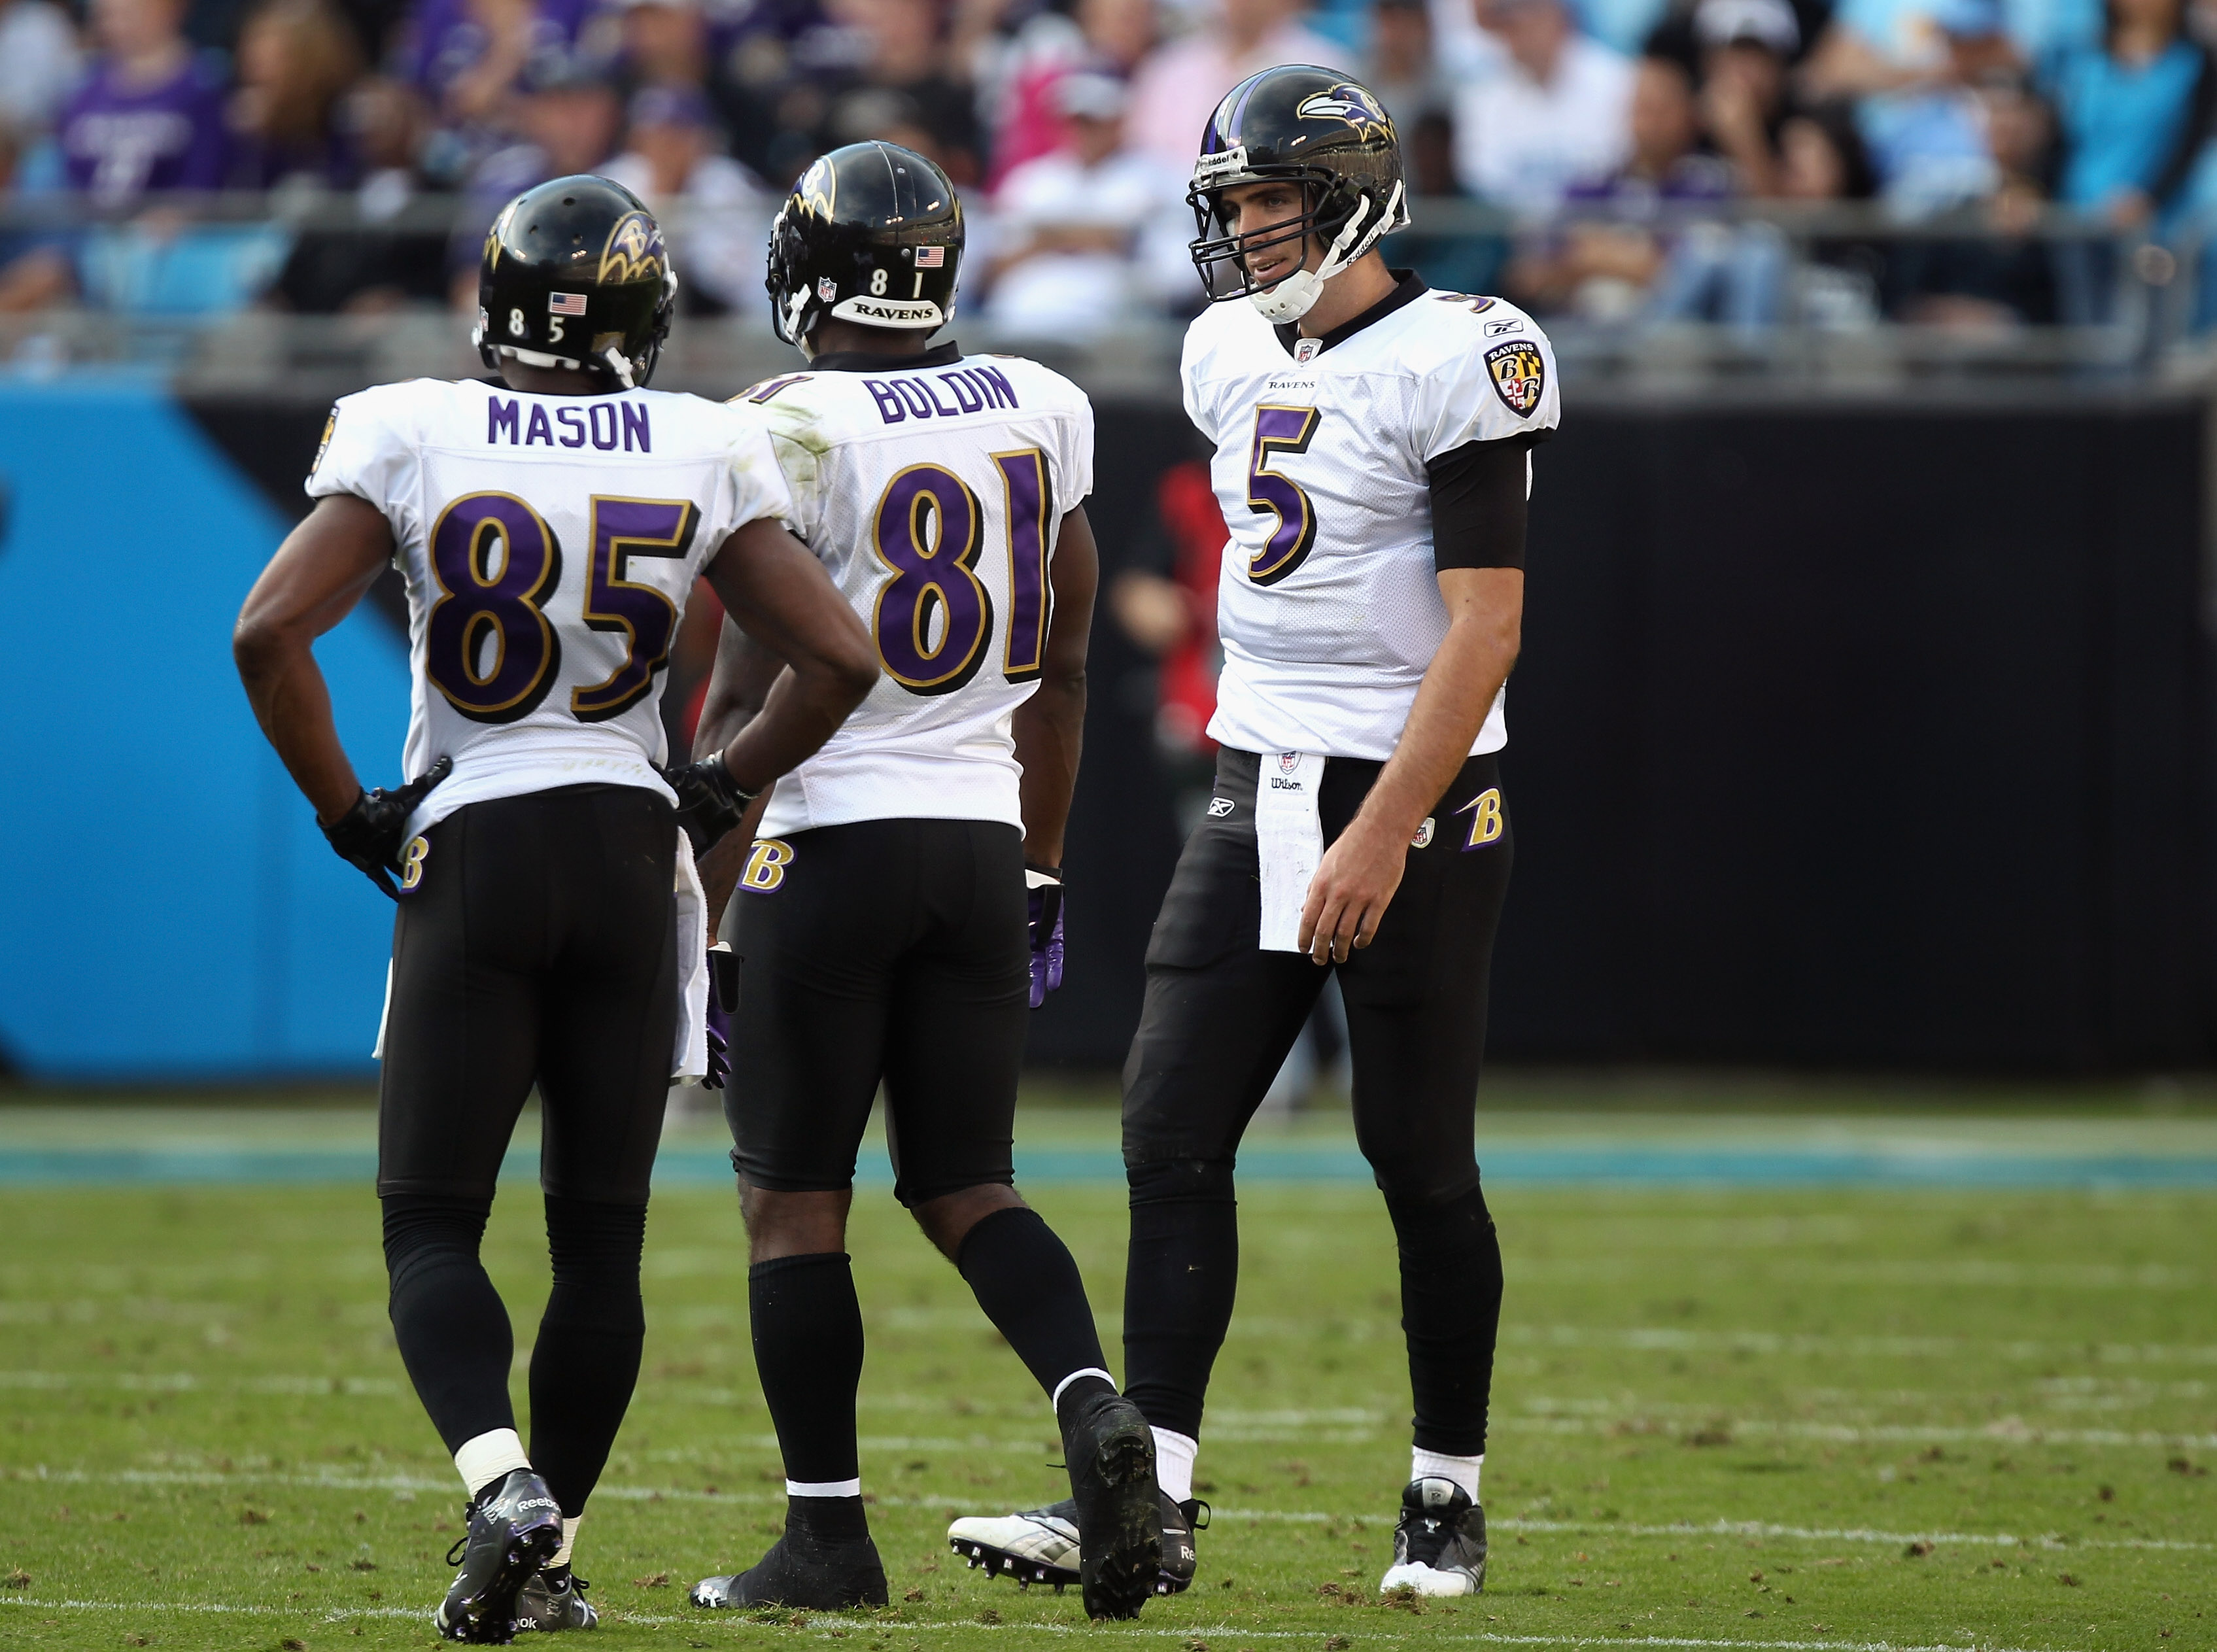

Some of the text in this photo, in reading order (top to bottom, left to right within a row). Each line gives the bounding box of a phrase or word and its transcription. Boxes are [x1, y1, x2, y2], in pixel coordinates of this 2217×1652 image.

[820, 286, 833, 299] NFL
[870, 268, 923, 298] 8 1
[509, 308, 524, 336] 8
[548, 316, 564, 345] 5
[853, 303, 935, 320] RAVENS
[1488, 342, 1534, 360] RAVENS
[861, 366, 1020, 424] BOLDIN
[1268, 381, 1316, 389] RAVENS
[1497, 357, 1539, 400] B R
[488, 395, 651, 453] MASON
[1246, 404, 1322, 587] 5
[871, 447, 1052, 697] 81
[425, 490, 701, 724] 85
[1282, 757, 1294, 769] NFL
[1271, 777, 1303, 791] Wilson
[1452, 787, 1504, 853] B
[400, 835, 431, 894] B
[738, 838, 797, 895] B
[517, 1496, 562, 1513] Reebo
